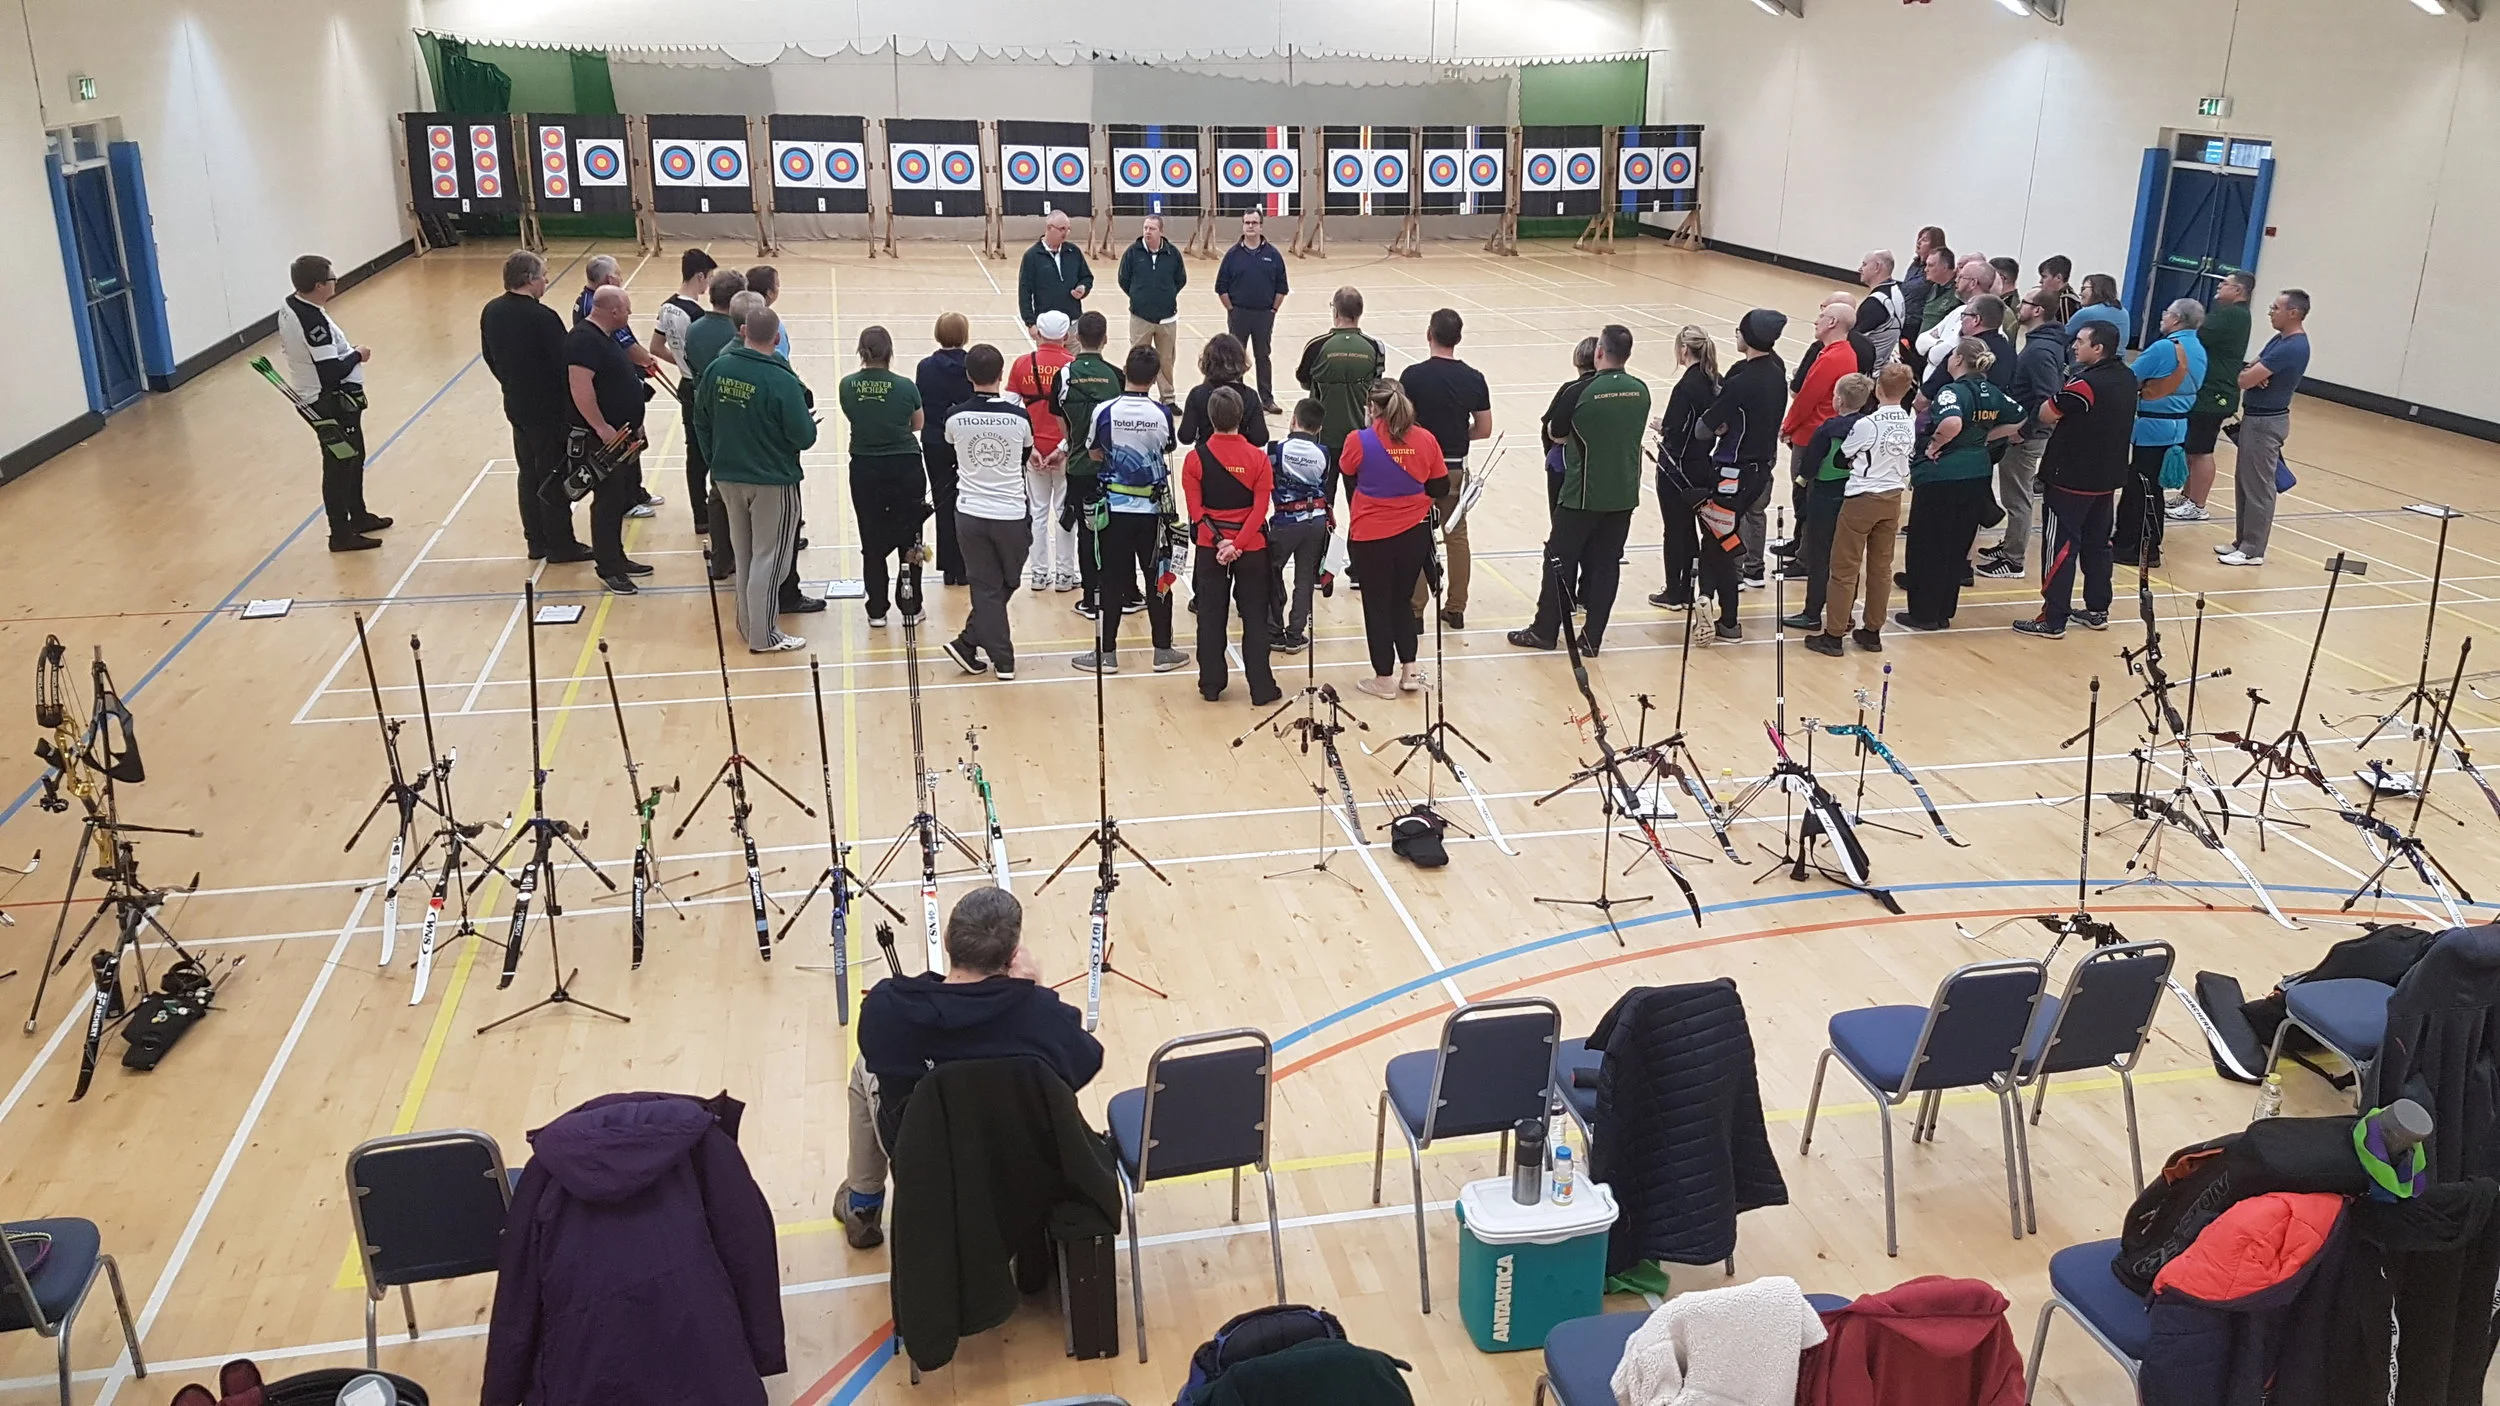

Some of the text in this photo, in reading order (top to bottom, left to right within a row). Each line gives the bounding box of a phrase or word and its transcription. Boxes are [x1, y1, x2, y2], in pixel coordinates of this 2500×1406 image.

[716, 376, 756, 394] HARVESTER
[851, 380, 893, 388] HARVESTER
[856, 386, 888, 394] ARCHERS
[718, 385, 751, 400] ARCHERS
[957, 417, 1018, 426] THOMPSON
[1135, 420, 1159, 429] Plant
[967, 431, 1012, 467] YORKSHIRE COUNTY TEAM
[1284, 454, 1318, 465] Total Plant
[1335, 767, 1351, 791] HOYT
[634, 876, 643, 889] SF
[515, 910, 526, 937] SYNERGY
[90, 990, 108, 1038] SF ARCHERY
[2187, 1000, 2213, 1031] ARCHERY
